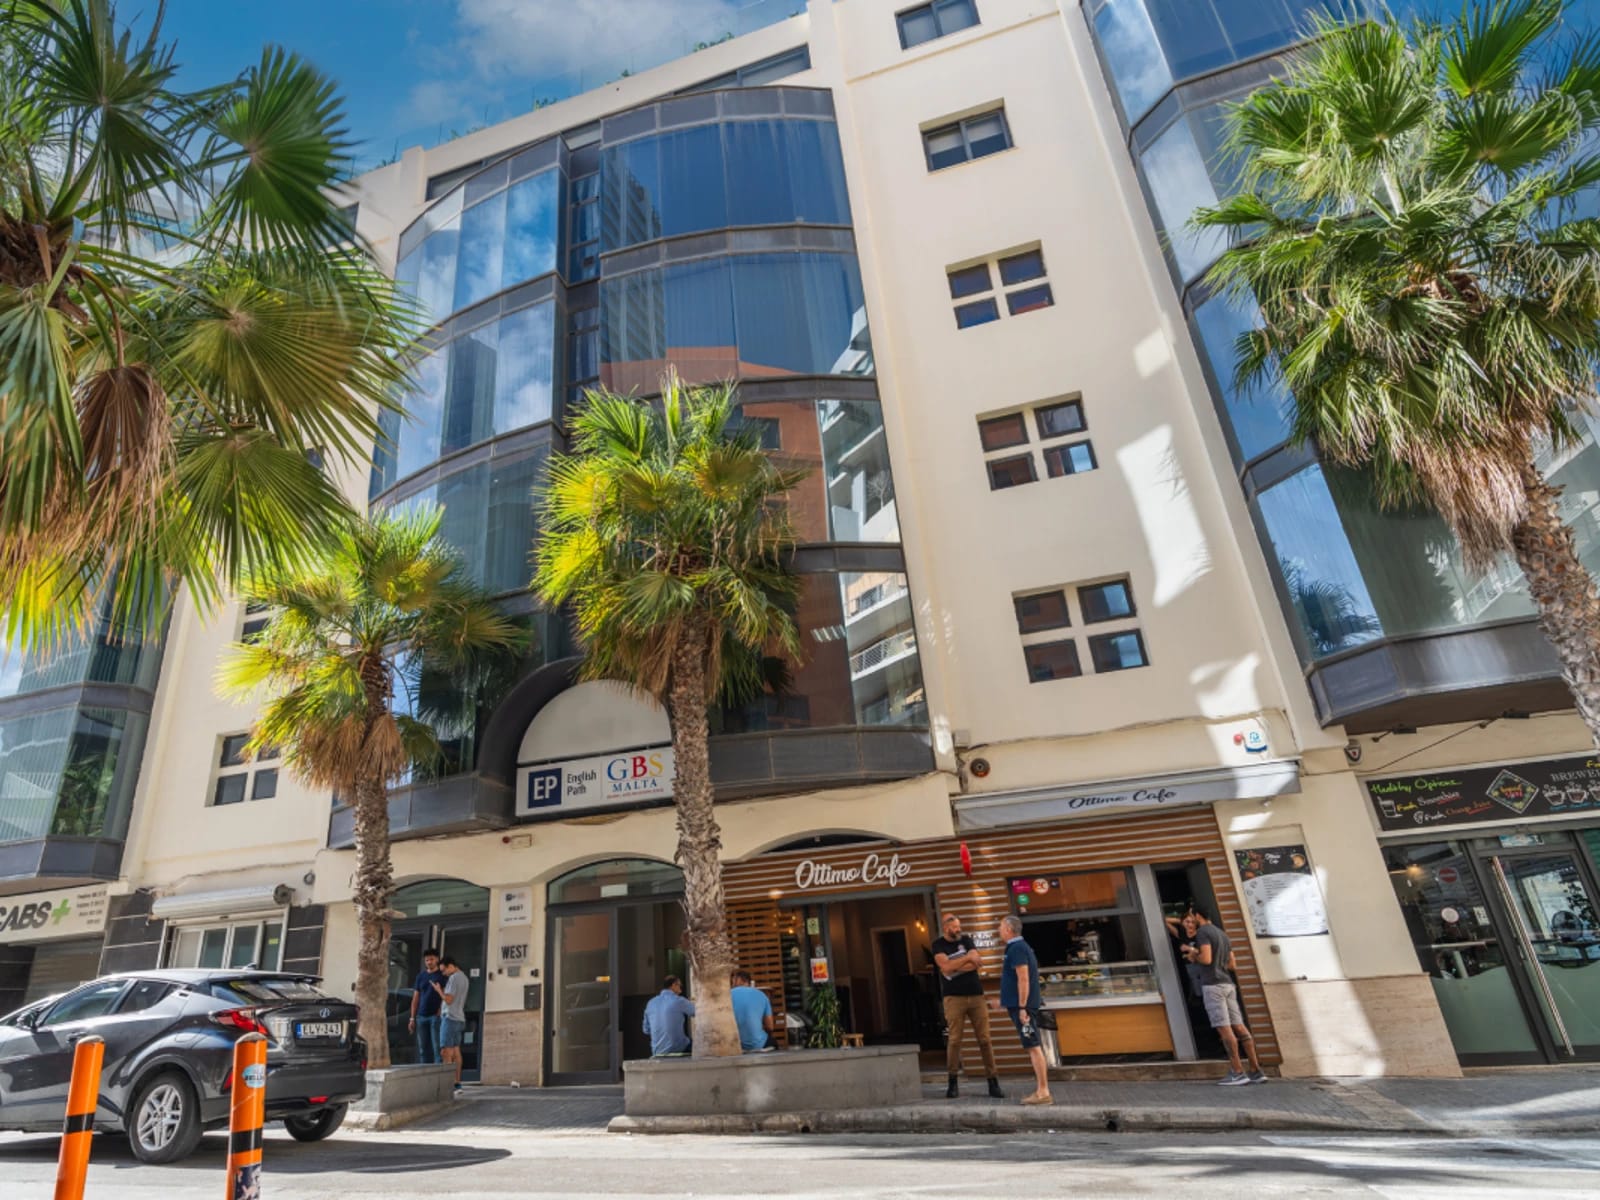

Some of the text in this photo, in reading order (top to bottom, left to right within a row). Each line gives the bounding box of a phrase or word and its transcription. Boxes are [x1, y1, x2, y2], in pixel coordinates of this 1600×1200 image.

[607, 753, 665, 781] GBS
[567, 769, 597, 785] English
[612, 779, 658, 792] MALTA
[533, 775, 558, 801] EP
[567, 786, 587, 797] Path
[1068, 788, 1177, 809] Ottimo Cafe
[795, 853, 911, 889] Ottimo Cafe
[501, 944, 529, 960] WEST
